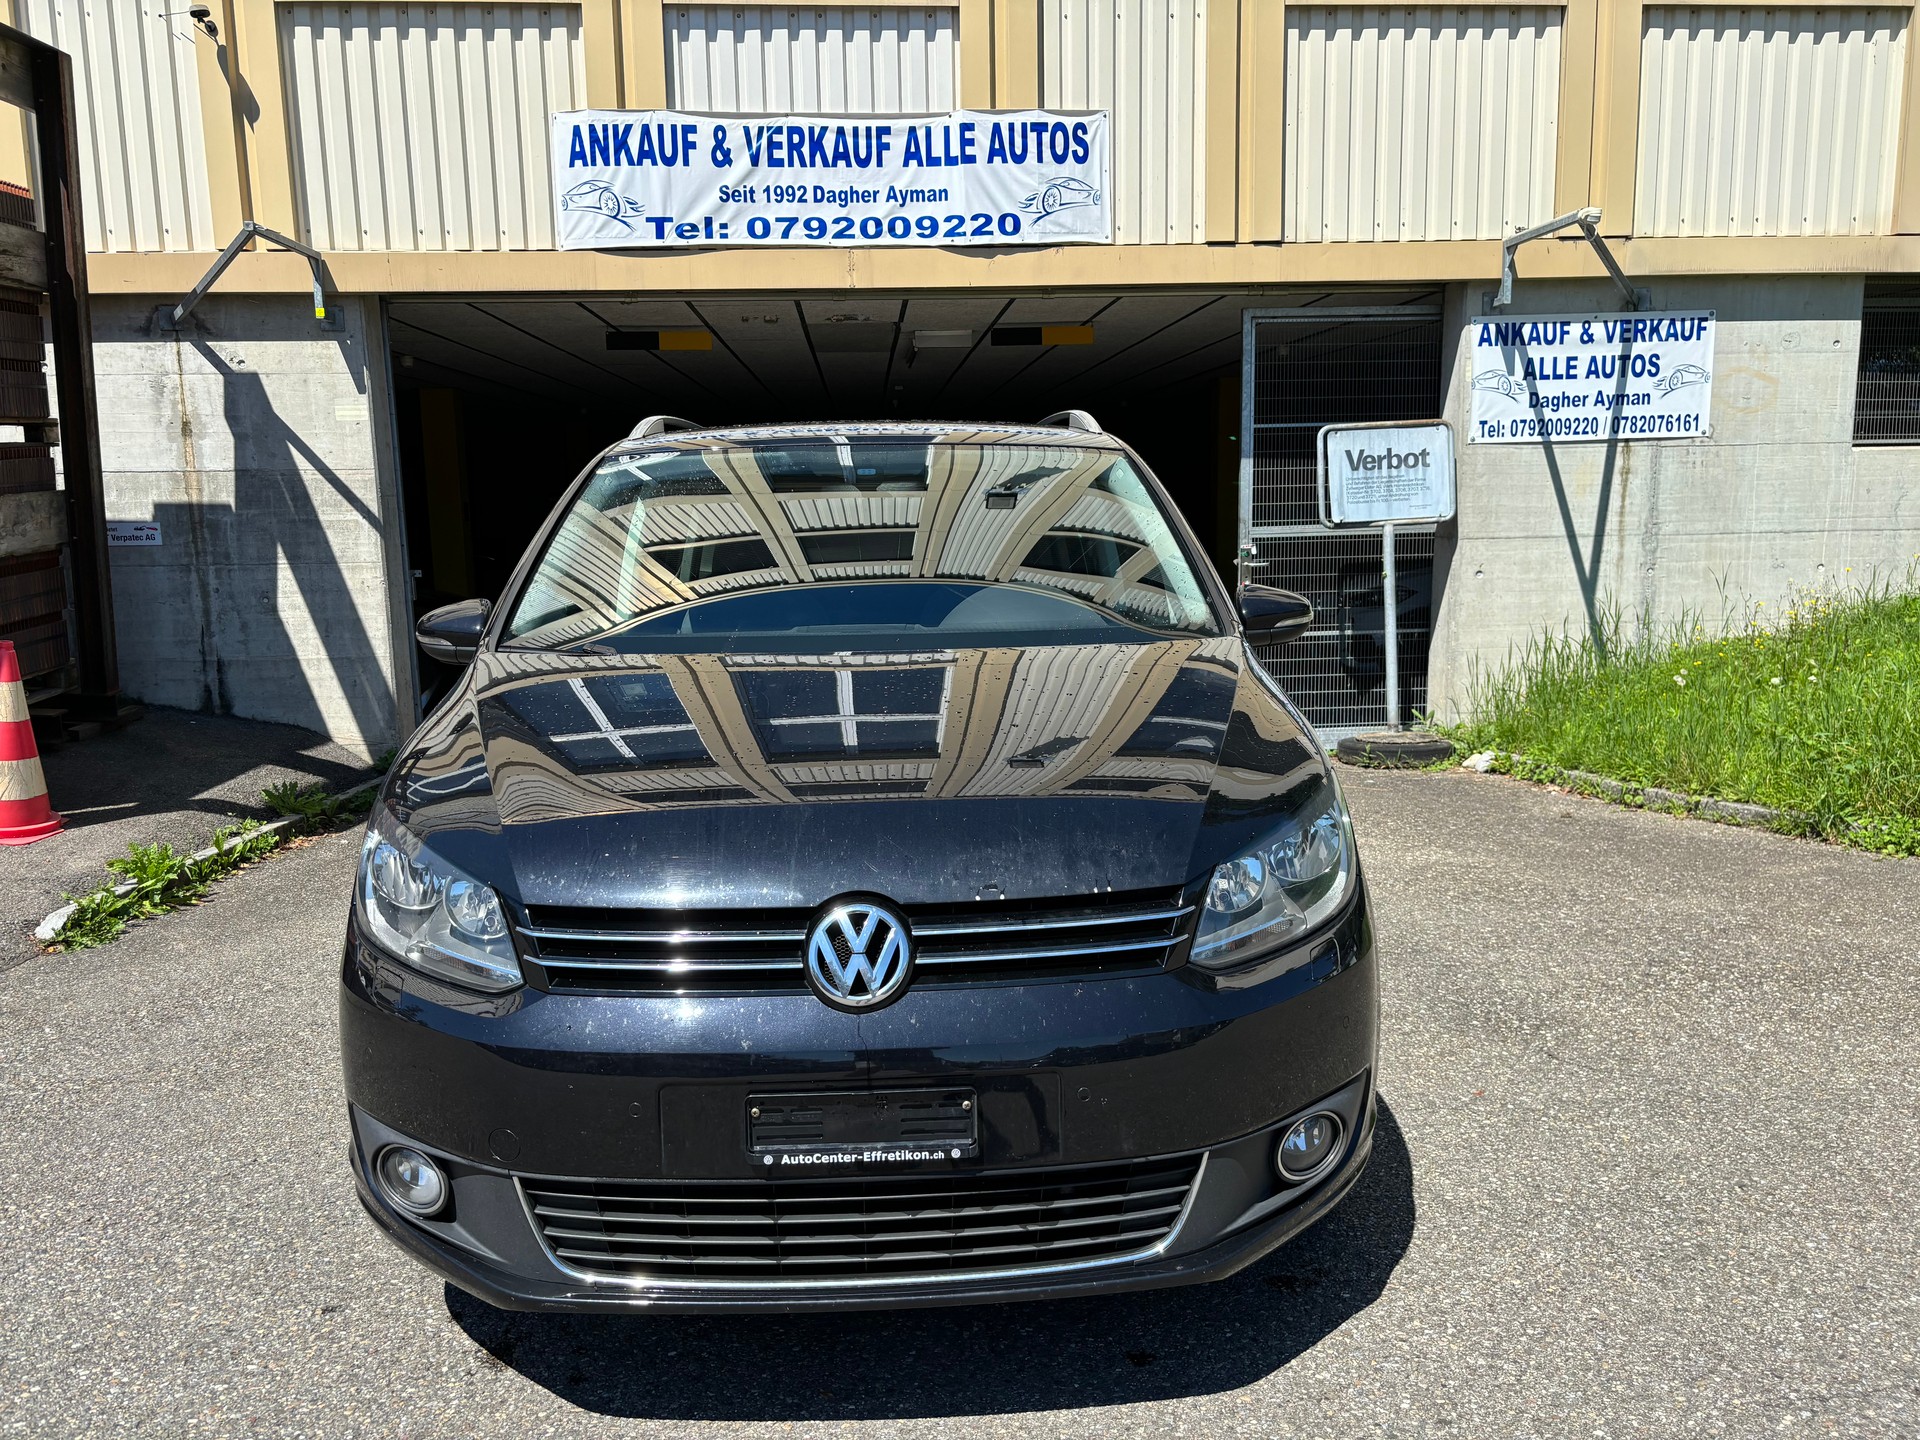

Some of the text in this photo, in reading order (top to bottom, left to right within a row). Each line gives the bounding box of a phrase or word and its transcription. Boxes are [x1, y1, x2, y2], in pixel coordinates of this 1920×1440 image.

[569, 121, 1089, 168] ANKAUF & VERKAUF ALLE AUTOS
[718, 184, 949, 208] Seit 1992 Dagher Ayman
[646, 212, 1022, 240] Tel: 0792009220
[1478, 316, 1709, 347] ANKAUF & VERKAUF
[1522, 353, 1661, 381] ALLE AUTOS
[1528, 389, 1652, 413] Dagher Ayman
[1479, 420, 1505, 438] Tel:
[1510, 417, 1599, 437] 0792009220
[1612, 413, 1700, 434] 0782076161
[1344, 447, 1431, 472] Verbot
[111, 534, 144, 542] Verpatec
[145, 533, 156, 541] AG
[781, 1151, 945, 1165] AutoCenter-Effretikon.ch
